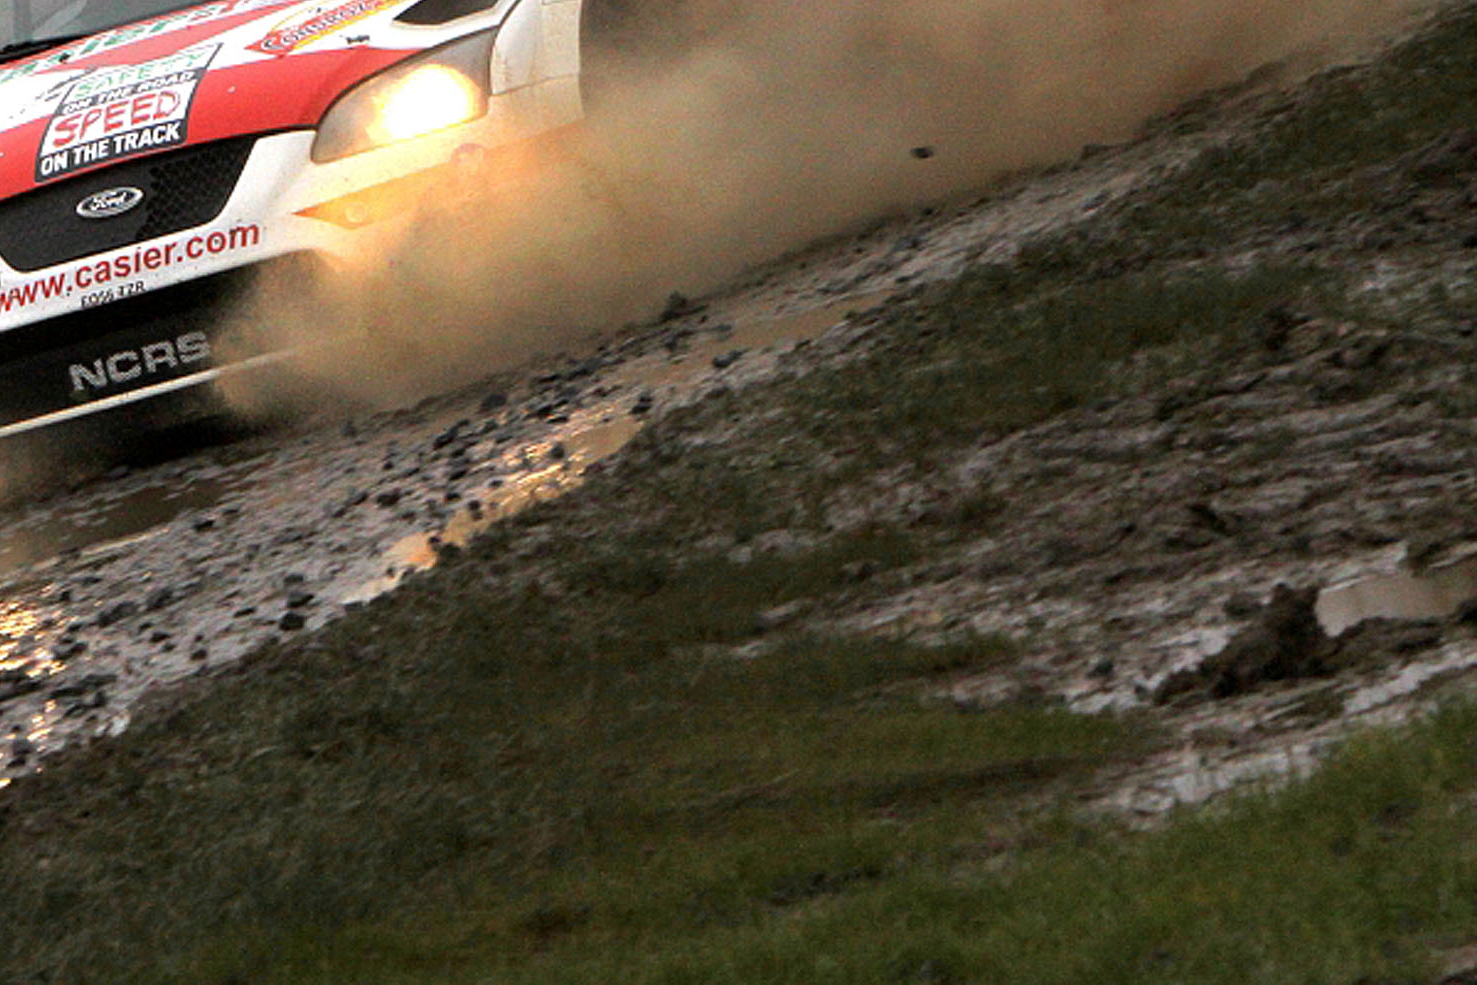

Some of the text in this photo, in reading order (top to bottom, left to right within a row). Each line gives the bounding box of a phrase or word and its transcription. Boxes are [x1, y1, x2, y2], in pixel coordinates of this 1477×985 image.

[53, 90, 181, 147] SPEED
[41, 121, 181, 176] ON THE TRACK
[69, 331, 211, 391] NCRS
